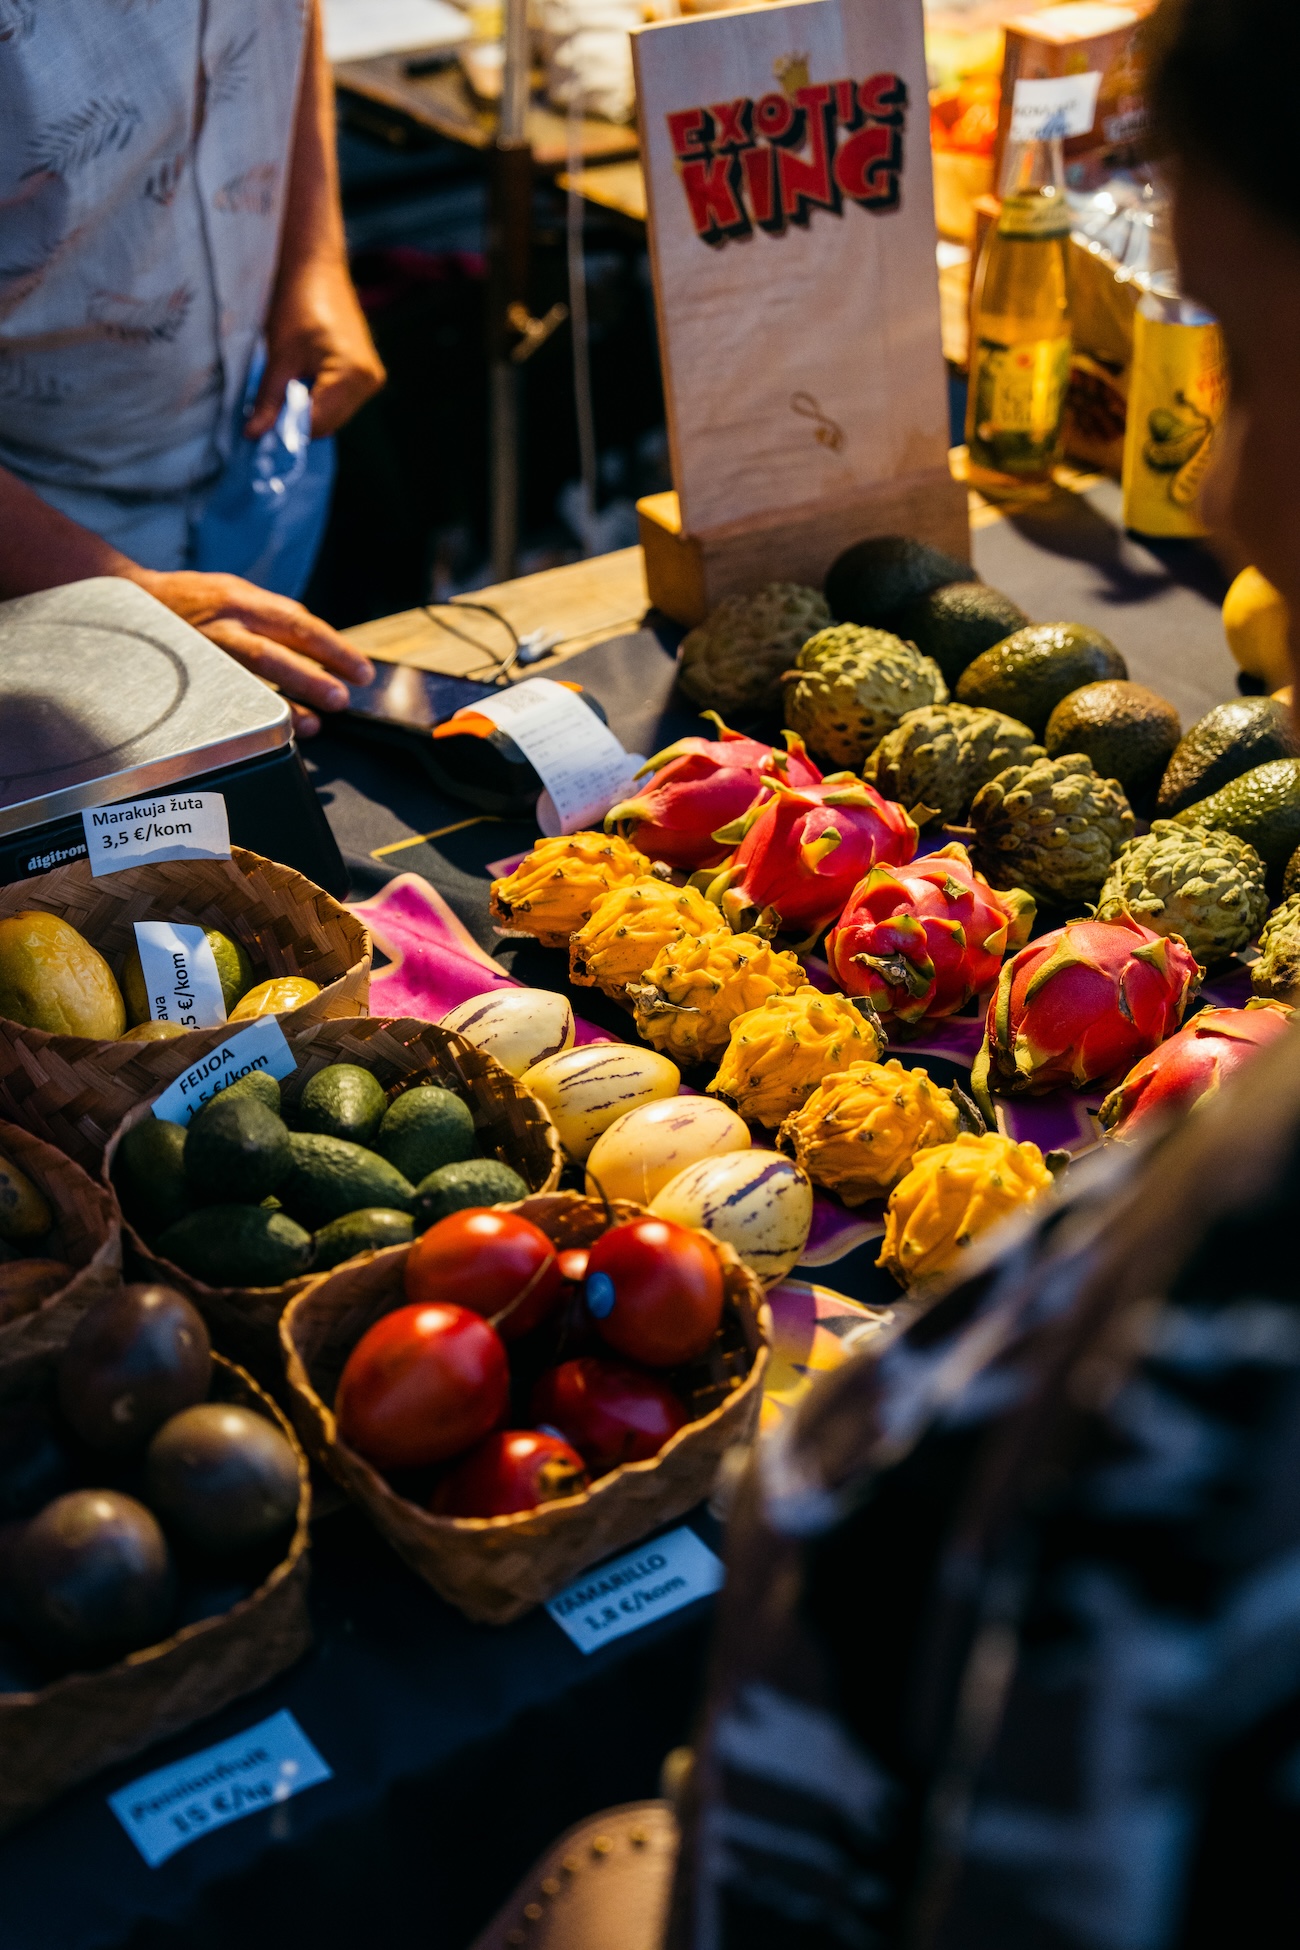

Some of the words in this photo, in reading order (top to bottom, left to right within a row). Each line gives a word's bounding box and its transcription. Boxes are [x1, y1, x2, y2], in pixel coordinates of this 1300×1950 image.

[666, 72, 909, 160] EXOTIC
[678, 124, 905, 250] KING
[92, 803, 166, 826] Marakuja
[170, 799, 203, 812] žuta
[102, 831, 130, 849] 3,5
[133, 822, 192, 842] €/kom
[27, 844, 87, 871] digitron
[172, 952, 196, 1010] €/kom
[155, 996, 169, 1021] ava
[181, 1015, 201, 1030] ,5
[179, 1048, 235, 1095] FEIJOA
[186, 1092, 210, 1116] 15
[553, 1553, 668, 1617] TAMARILLO
[618, 1575, 687, 1613] €/kom
